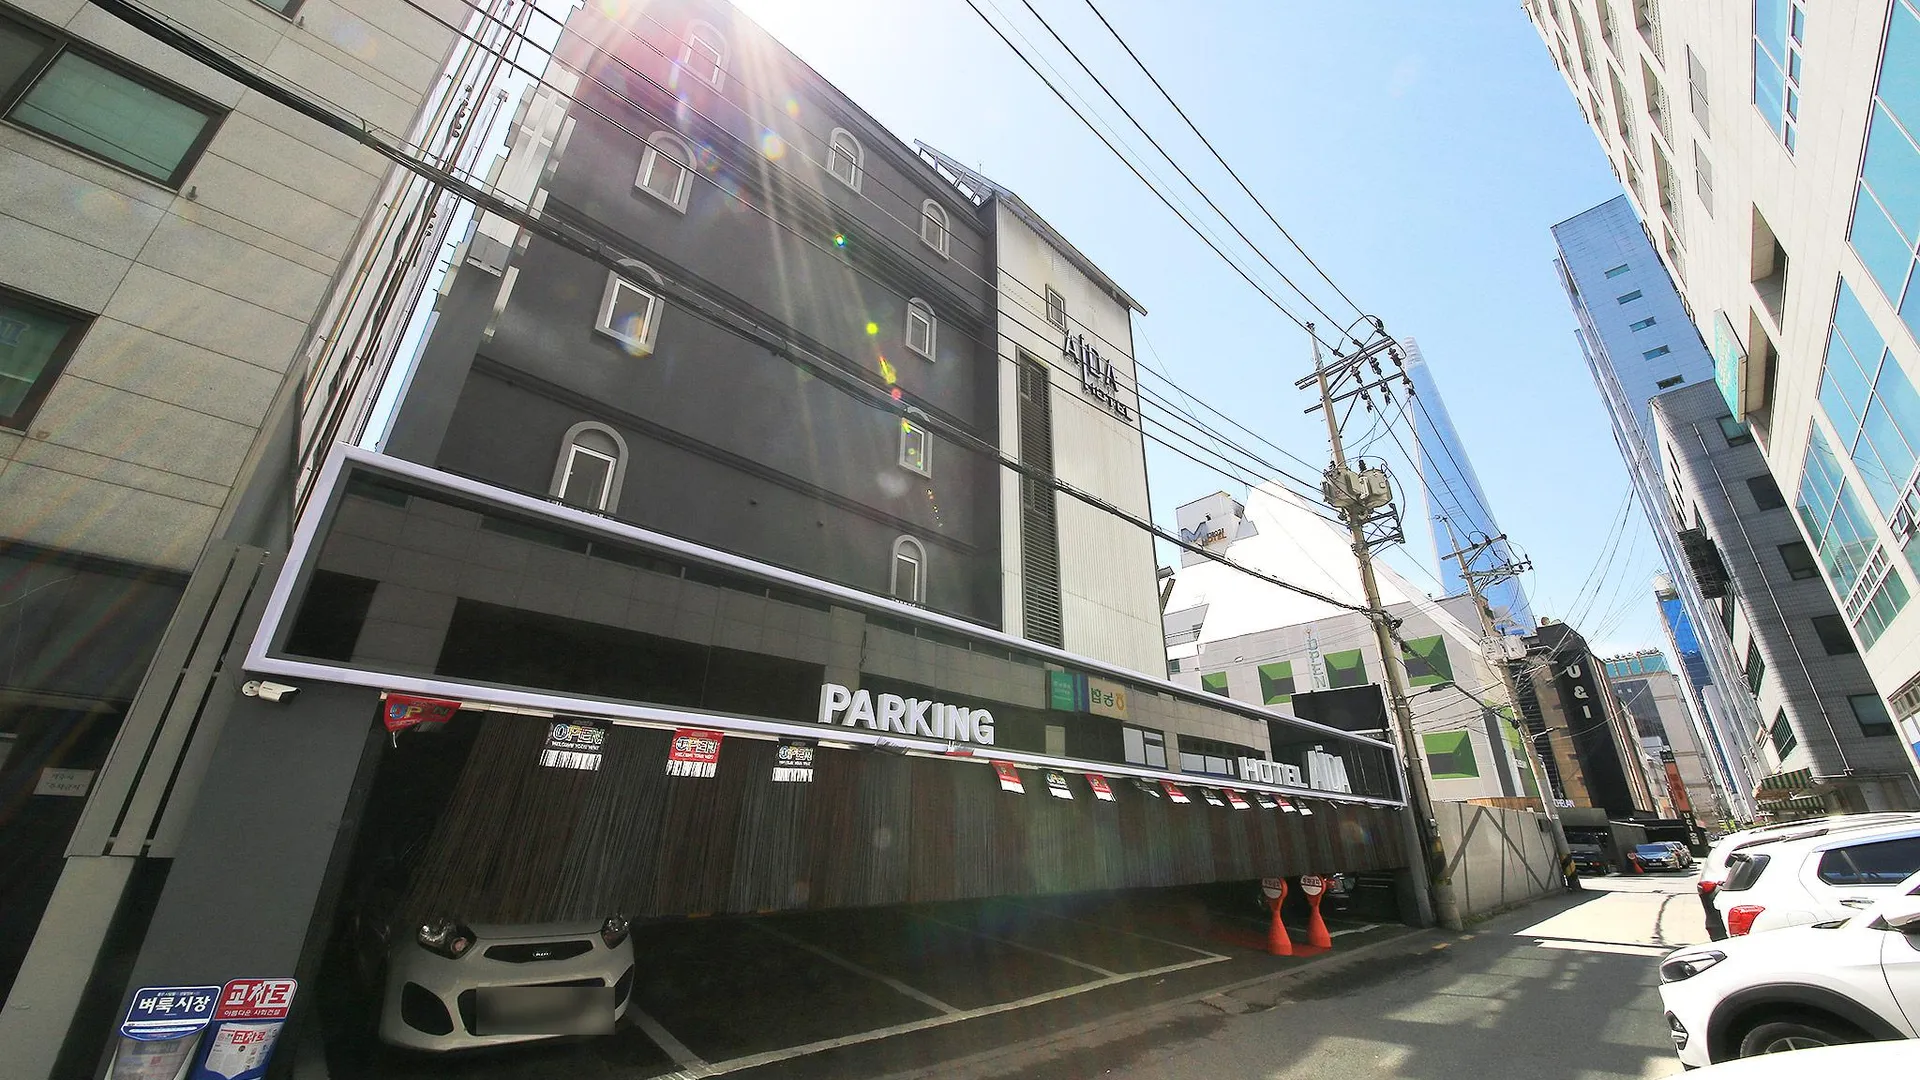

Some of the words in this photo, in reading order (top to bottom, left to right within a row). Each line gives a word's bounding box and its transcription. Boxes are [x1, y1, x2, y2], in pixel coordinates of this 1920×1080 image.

[1083, 382, 1134, 422] HOTEL
[818, 682, 995, 746] PARKING
[553, 723, 606, 745] OPEN
[675, 736, 718, 754] OPEN
[779, 745, 814, 761] OPEN
[1238, 756, 1309, 789] HOTEL
[138, 994, 211, 1015] 벼룩시장
[225, 981, 294, 1009] 교차로
